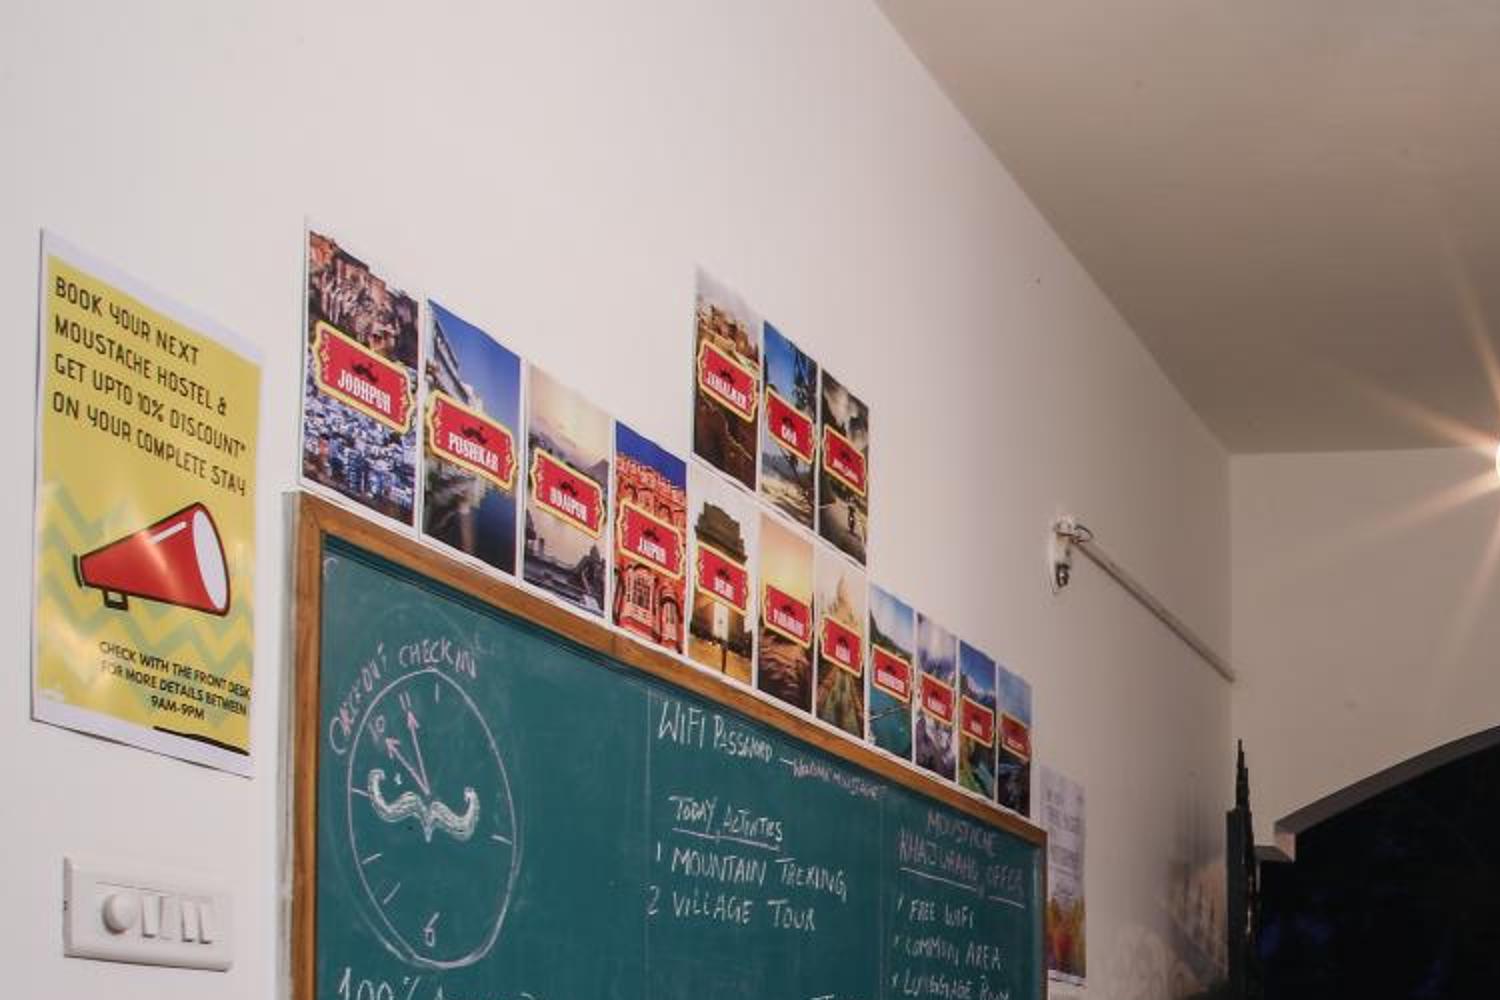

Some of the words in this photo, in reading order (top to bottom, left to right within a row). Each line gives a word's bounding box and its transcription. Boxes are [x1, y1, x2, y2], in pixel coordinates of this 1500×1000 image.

[55, 275, 103, 318] BOOK
[109, 301, 151, 343] YOUR
[156, 329, 200, 366] NEXT
[54, 314, 152, 380] MOUSTACHE
[157, 365, 213, 411] HOSTEL
[216, 396, 227, 417] &
[54, 353, 87, 384] GET
[92, 369, 133, 406] UPTO
[137, 391, 165, 423] 10%
[337, 369, 392, 415] JODHPUR
[52, 391, 80, 421] ON
[87, 403, 132, 443] YOUR
[137, 428, 208, 480] COMPLETE
[211, 465, 247, 497] STAY
[448, 431, 500, 475] PUSHKAR
[99, 641, 137, 664] CHECK
[139, 652, 169, 674] WITH
[171, 663, 193, 680] THE
[194, 669, 228, 692] FRONT
[228, 681, 252, 700] DESK
[400, 637, 454, 668] CHECK
[100, 659, 124, 679] FOR
[125, 668, 157, 690] MORE
[159, 678, 204, 703] DETAILS
[204, 690, 248, 717] BETWEEN
[151, 695, 206, 721] 9AM-9PM
[658, 700, 706, 749] WIFI
[668, 796, 718, 834] TODAY
[671, 846, 767, 887] MOUNTAIN
[423, 912, 440, 947] 6
[647, 885, 660, 916] 2
[672, 890, 753, 925] VILLAGE
[767, 899, 816, 931] TOUR
